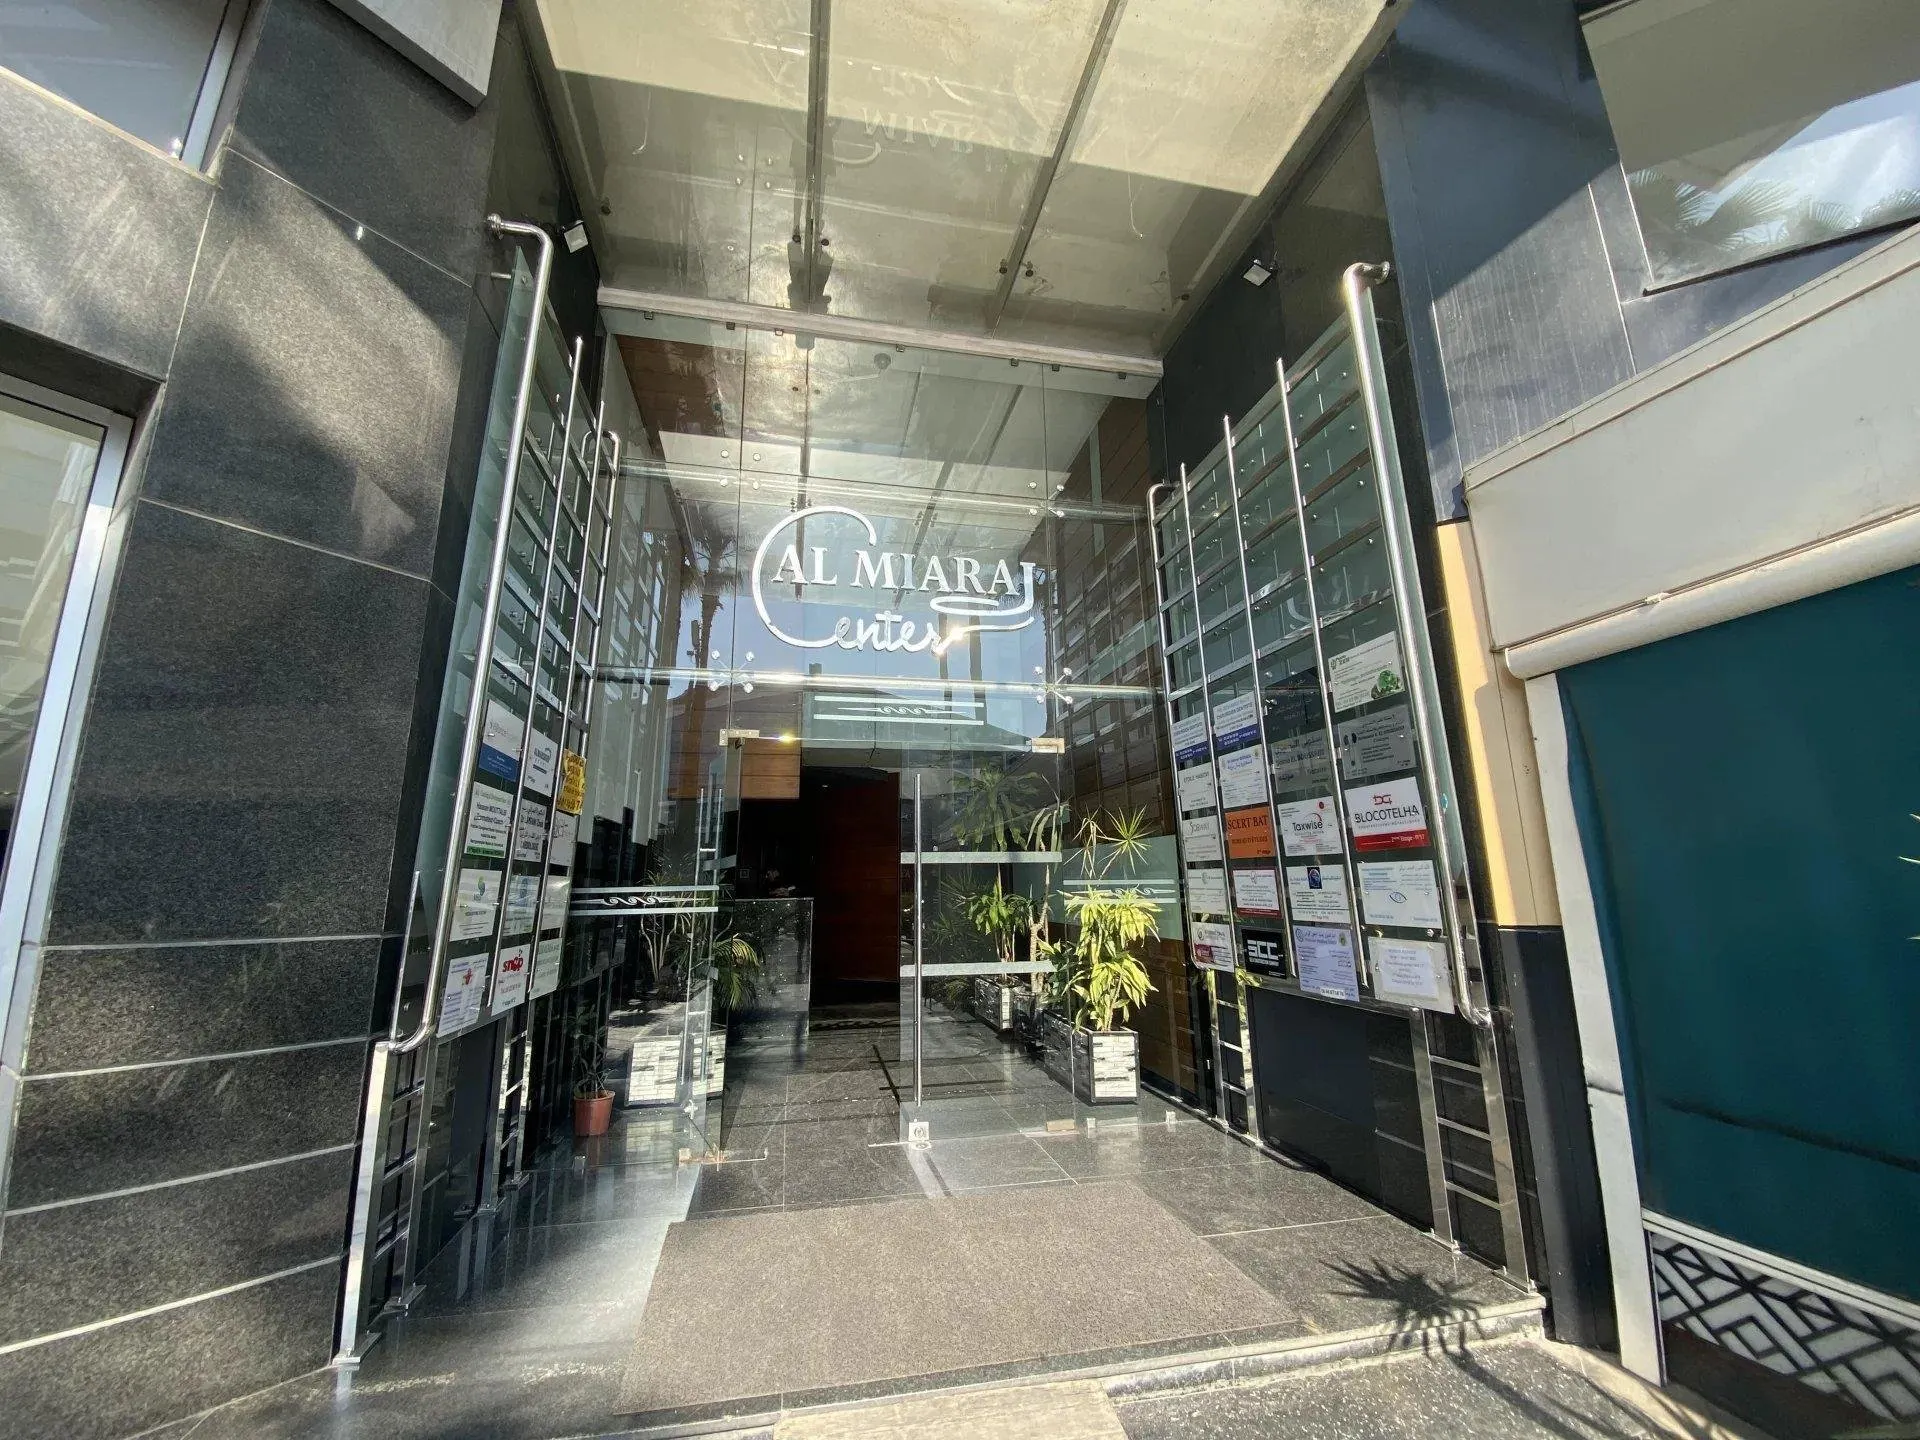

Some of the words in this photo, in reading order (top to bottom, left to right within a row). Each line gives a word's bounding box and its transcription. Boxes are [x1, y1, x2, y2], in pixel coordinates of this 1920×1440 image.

[771, 544, 838, 587] AL
[850, 550, 1037, 616] MIARAJ
[1354, 804, 1420, 823] BLOCOTELHA
[1228, 817, 1251, 830] SCERT
[1252, 815, 1269, 827] BAT
[1292, 820, 1323, 831] Taxwise
